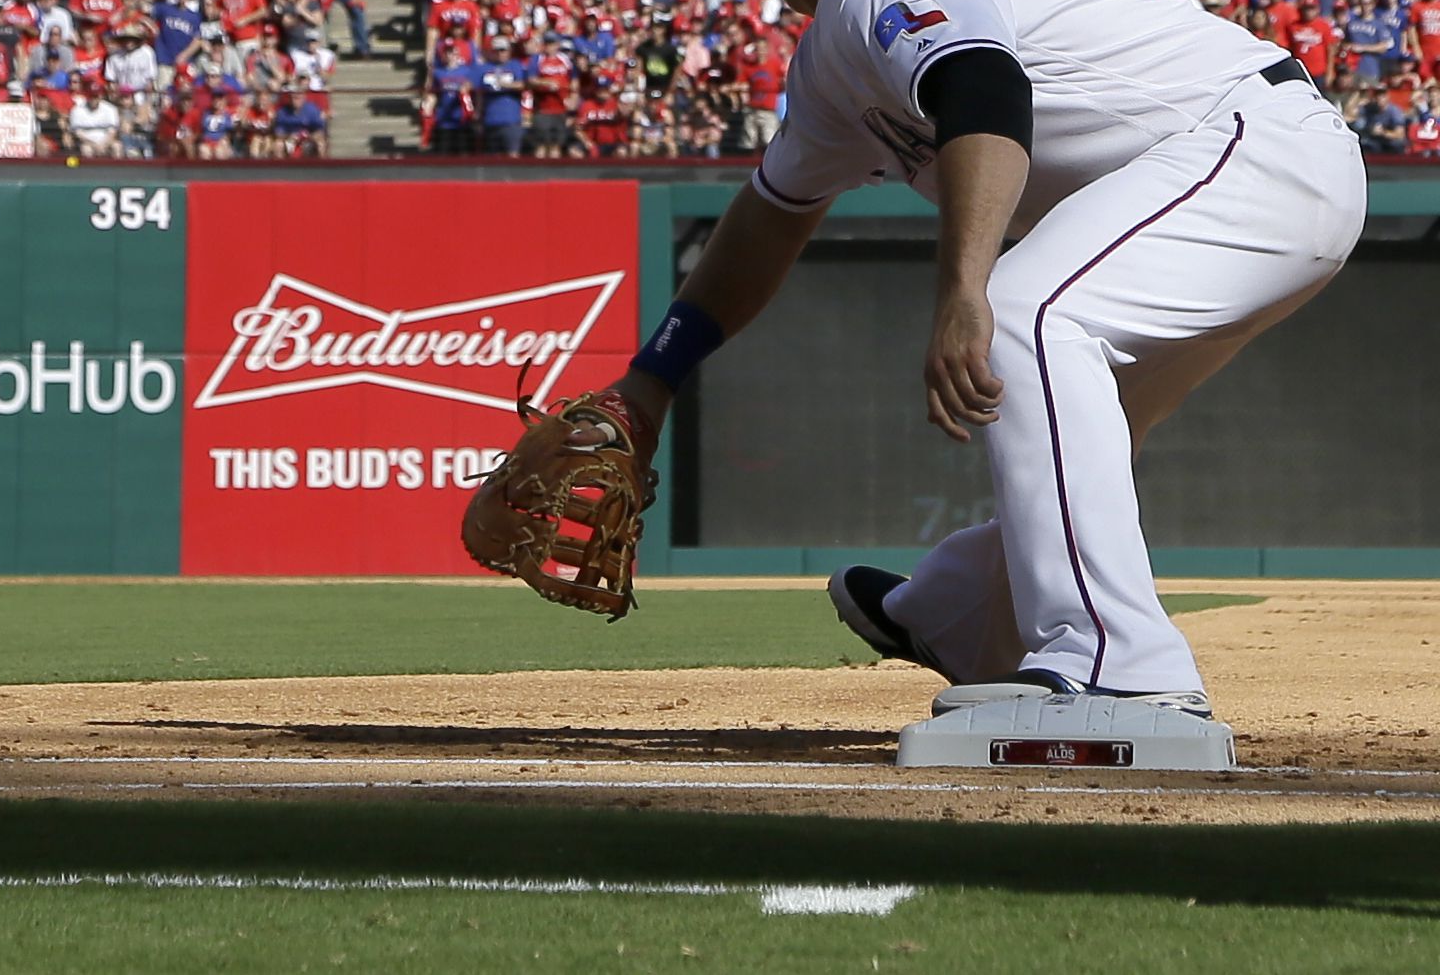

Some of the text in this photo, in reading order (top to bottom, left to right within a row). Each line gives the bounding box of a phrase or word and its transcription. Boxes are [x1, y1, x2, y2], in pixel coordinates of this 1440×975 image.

[90, 188, 170, 229] 354
[232, 306, 578, 371] Budweiser
[209, 447, 298, 490] THIS
[307, 447, 423, 490] BUD'S
[992, 742, 1010, 762] T
[1112, 744, 1130, 764] T
